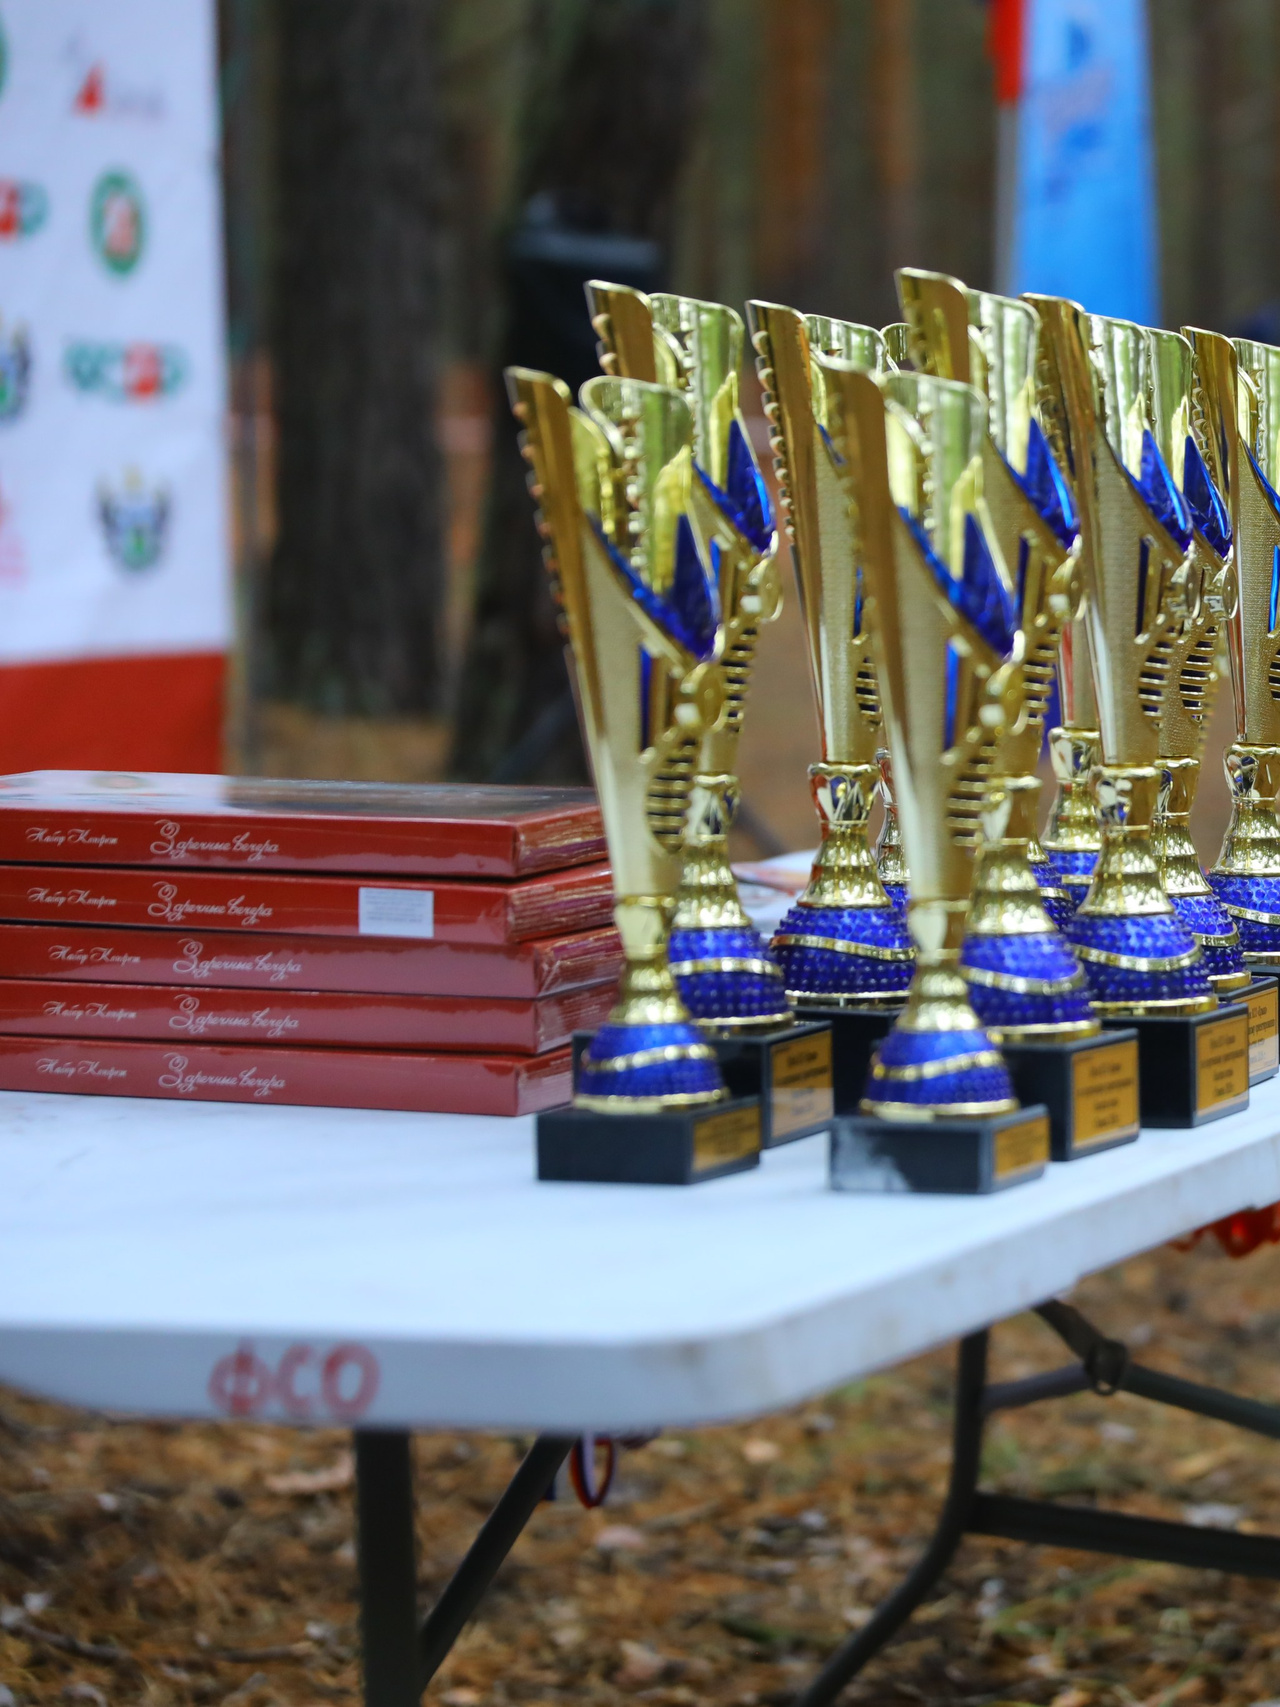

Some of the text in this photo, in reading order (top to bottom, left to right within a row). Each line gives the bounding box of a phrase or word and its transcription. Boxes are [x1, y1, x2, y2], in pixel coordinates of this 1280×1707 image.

[150, 819, 230, 859] Заречные
[147, 881, 225, 922] Заречные
[173, 938, 253, 978] Заречные
[169, 994, 250, 1034] Заречные
[158, 1052, 237, 1092] Заречные
[207, 1339, 380, 1421] ФСО
